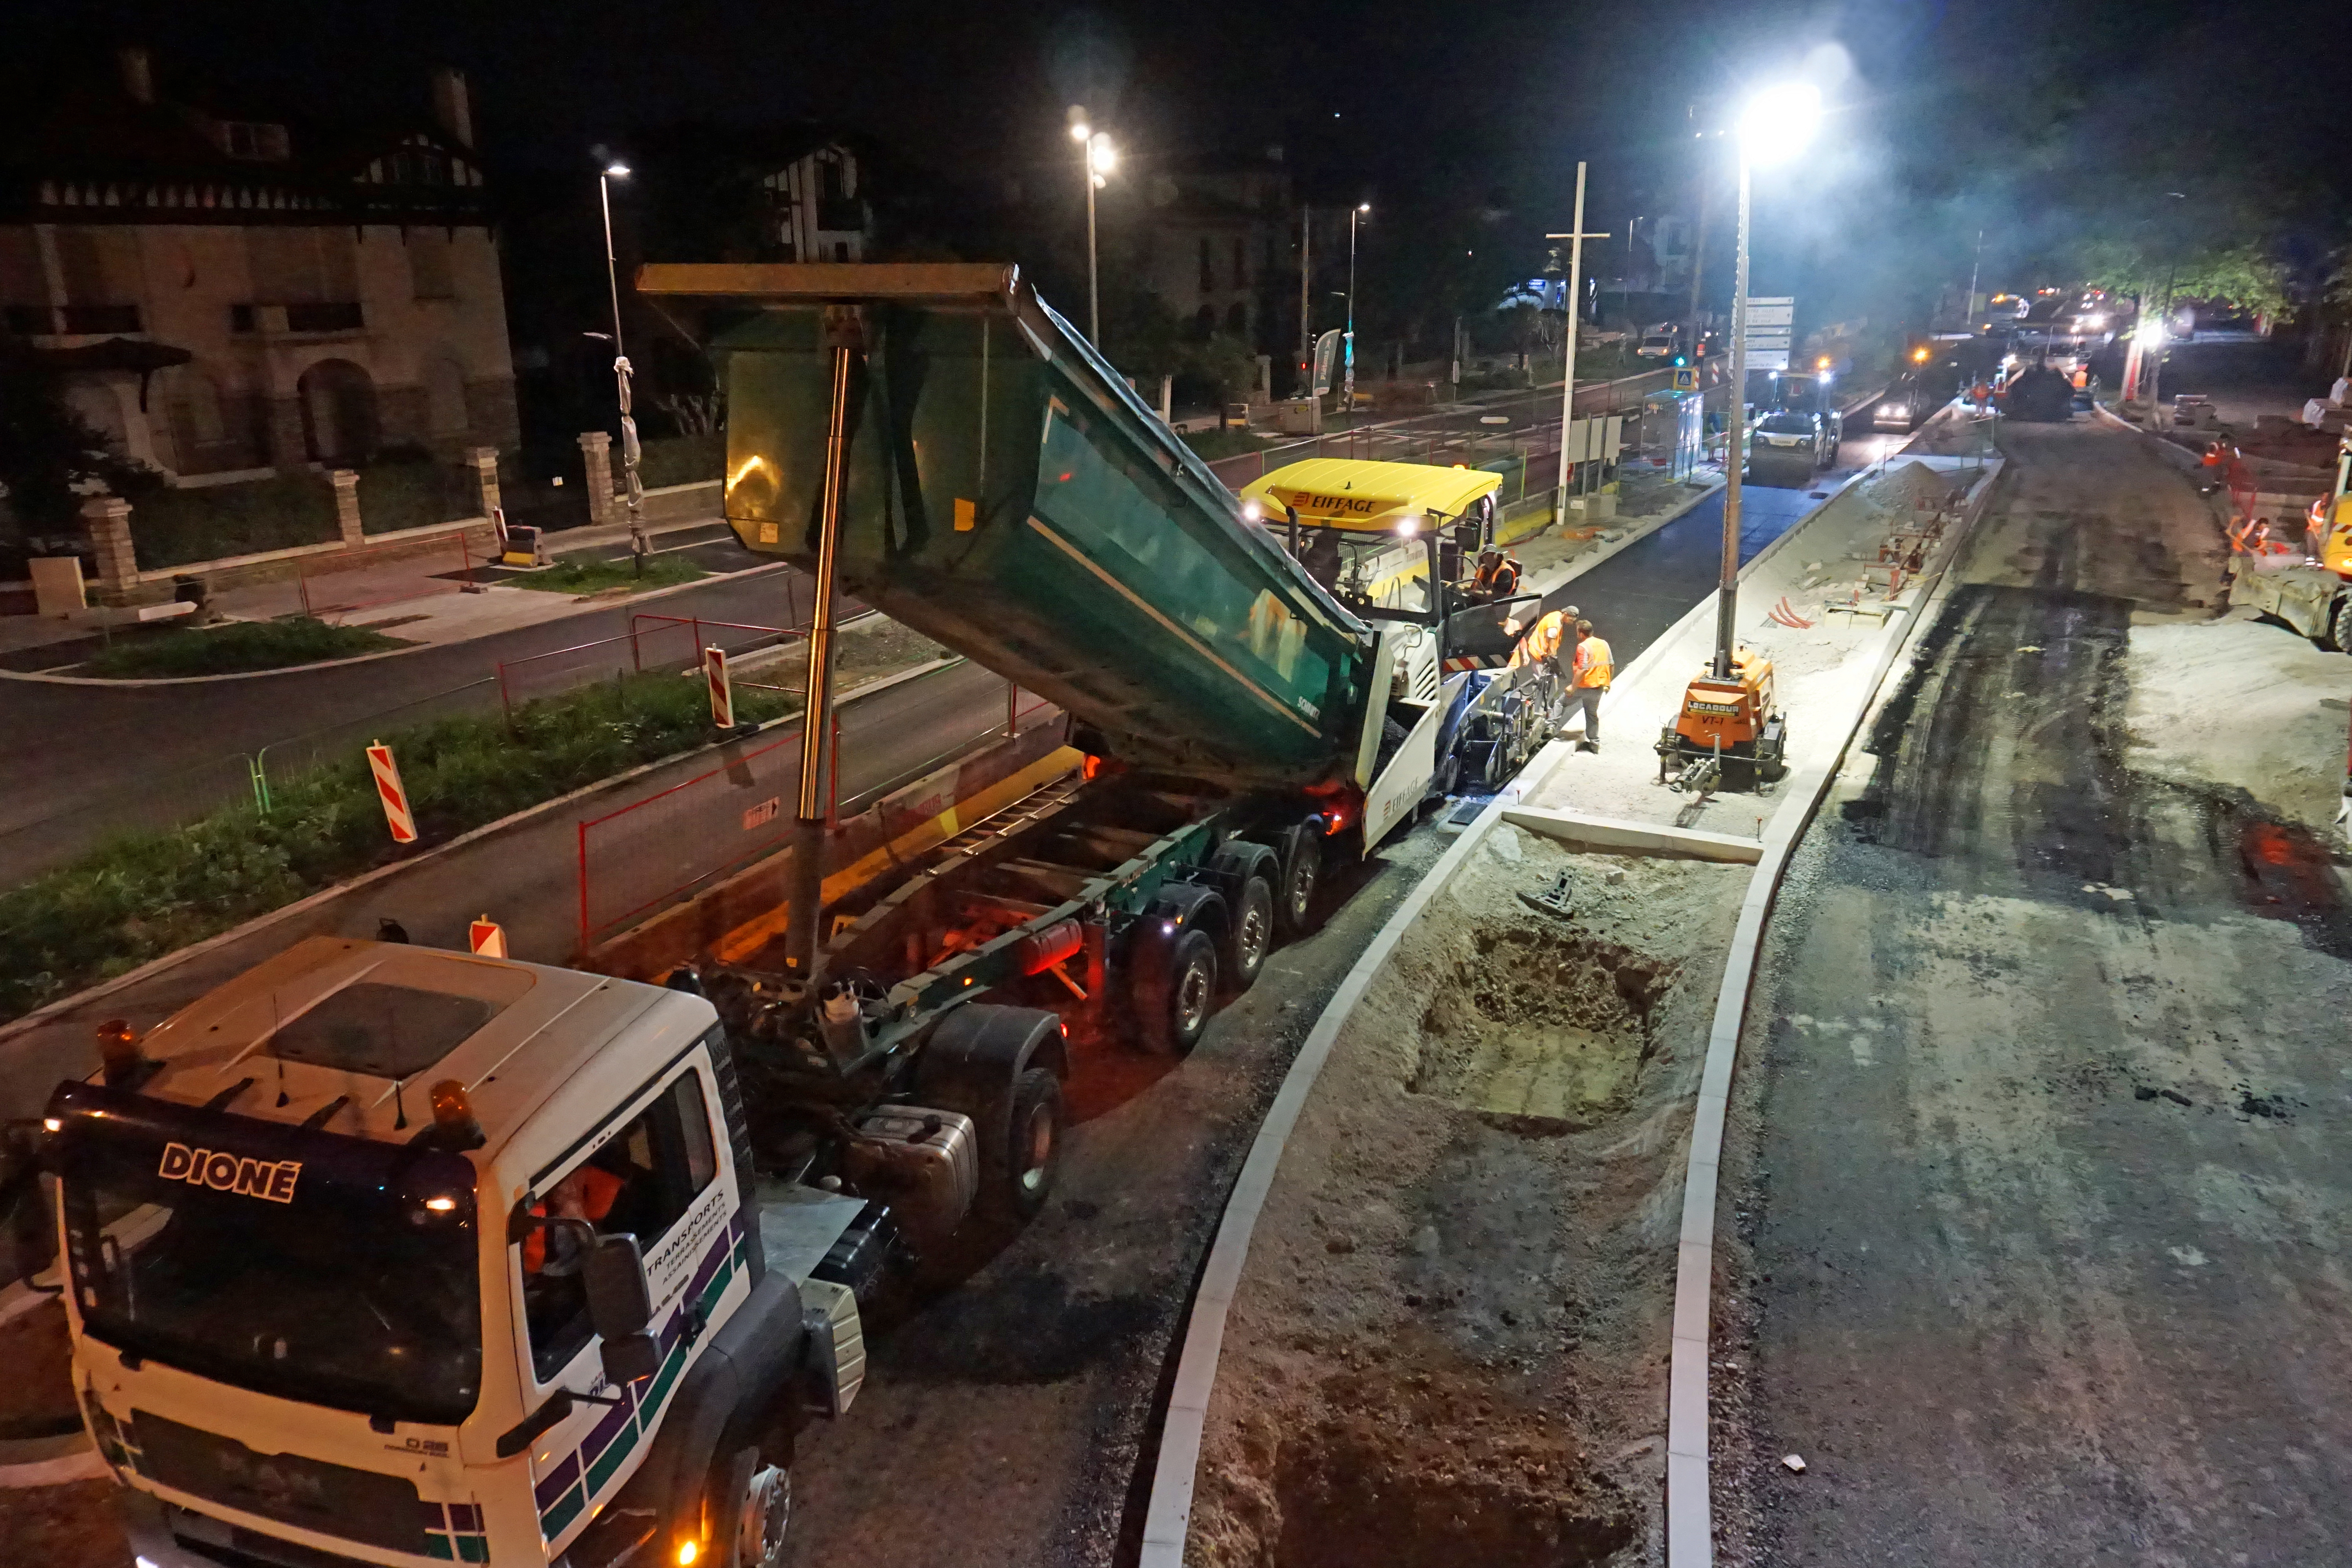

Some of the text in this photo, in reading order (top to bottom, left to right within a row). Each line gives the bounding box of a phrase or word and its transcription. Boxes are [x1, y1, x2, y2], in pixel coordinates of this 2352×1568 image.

[1312, 497, 1376, 513] EIFFAGE
[1688, 701, 1739, 712] LOCADOUR
[1393, 777, 1419, 812] EIFFAGE
[158, 1142, 302, 1203] DIONÉ
[646, 1189, 724, 1277] TRANSPORTS
[662, 1211, 727, 1285] ASSAINISSEMENTS
[666, 1202, 725, 1269] TERRASSEMENTS
